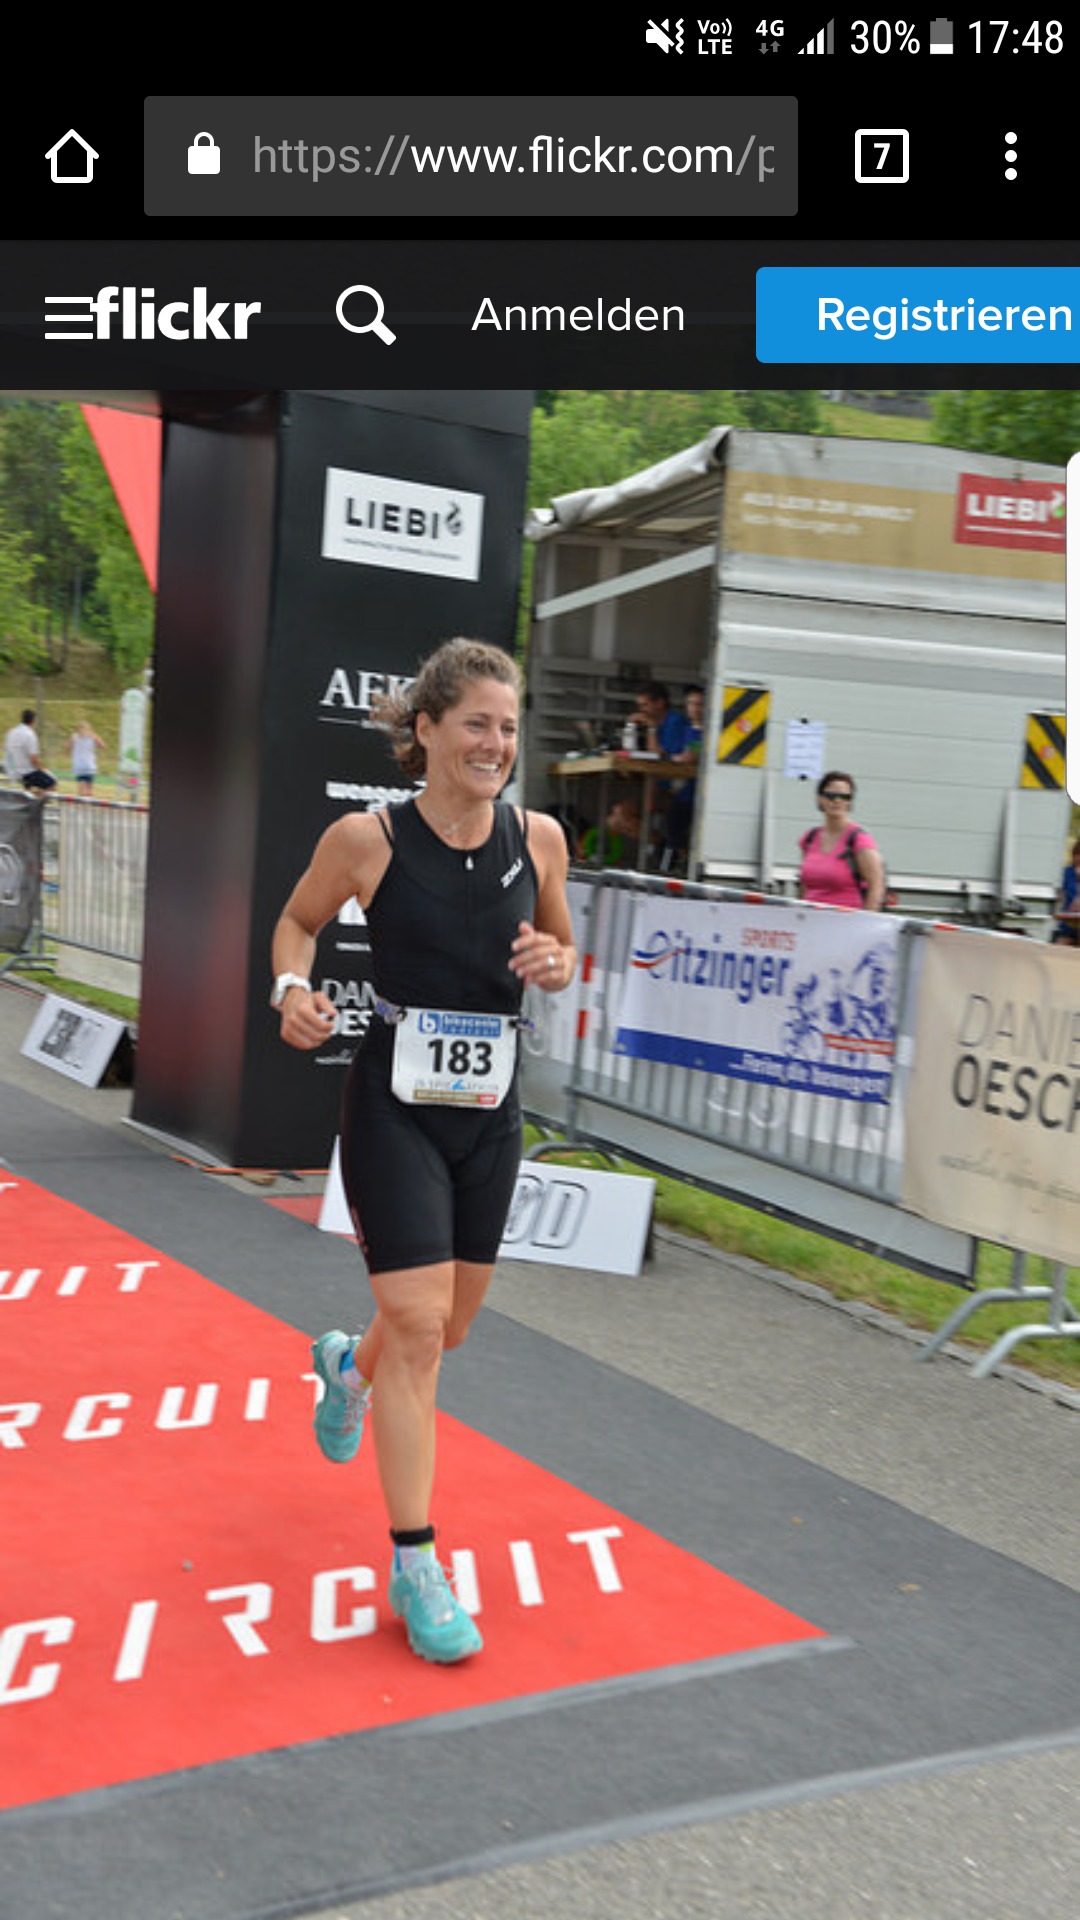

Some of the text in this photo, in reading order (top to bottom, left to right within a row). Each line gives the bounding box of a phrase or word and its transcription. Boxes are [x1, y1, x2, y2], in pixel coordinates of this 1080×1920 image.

[698, 38, 733, 55] LTE
[755, 19, 785, 37] 4G
[850, 19, 921, 55] 30%
[968, 19, 1064, 55] 17:48
[873, 142, 891, 170] 7
[90, 286, 1073, 341] flickr Anmelden Registrieren
[345, 498, 440, 540] LIEBI
[966, 493, 1048, 522] LIEBI
[427, 1038, 493, 1077] 183
